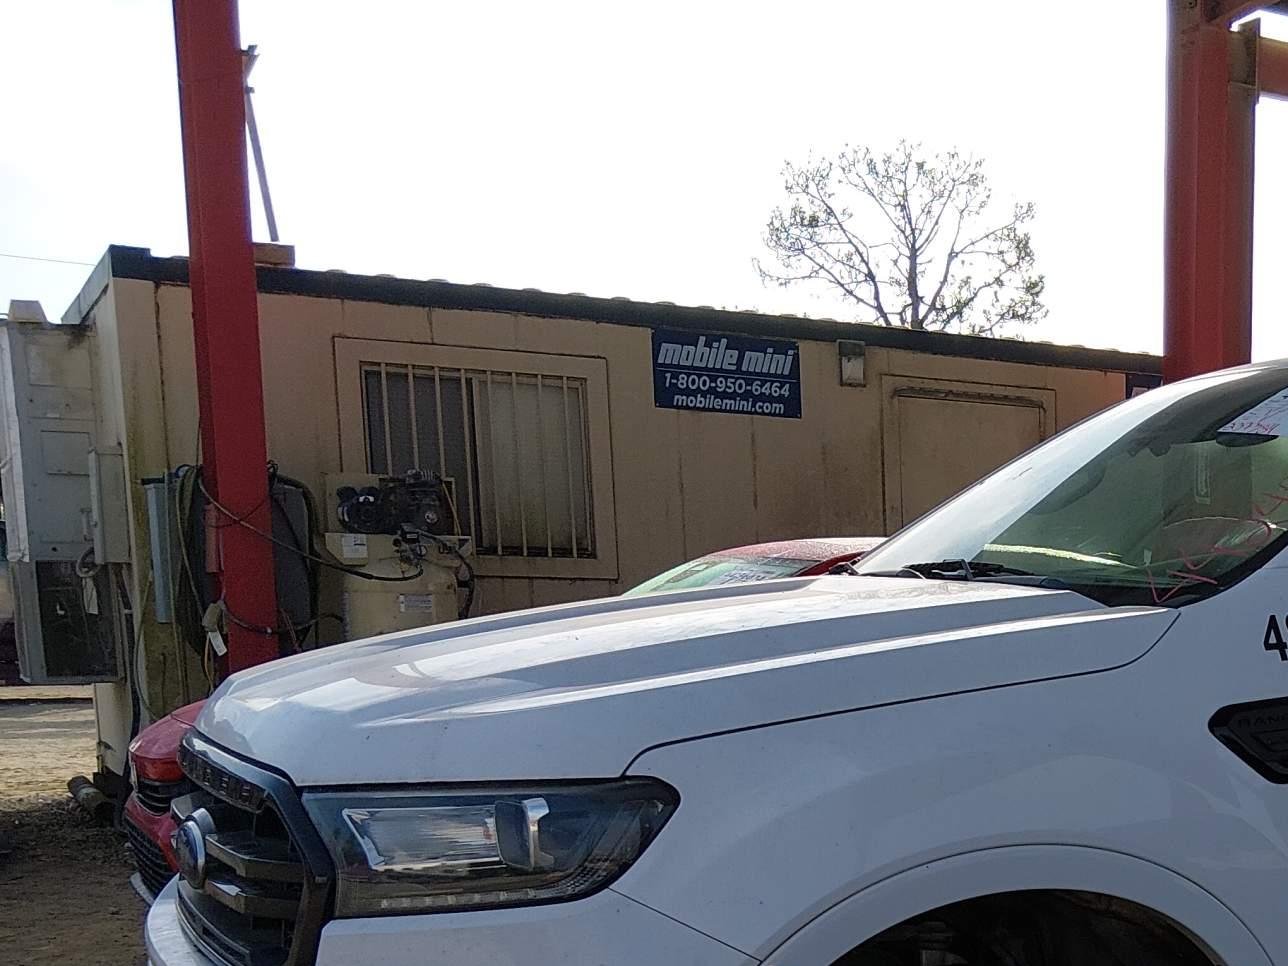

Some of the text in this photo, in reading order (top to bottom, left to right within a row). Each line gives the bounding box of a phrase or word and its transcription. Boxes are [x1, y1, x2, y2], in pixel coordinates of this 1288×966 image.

[657, 336, 793, 375] mobile mini
[664, 373, 790, 398] 1-800-950-6464
[673, 393, 784, 414] mobilemini.com
